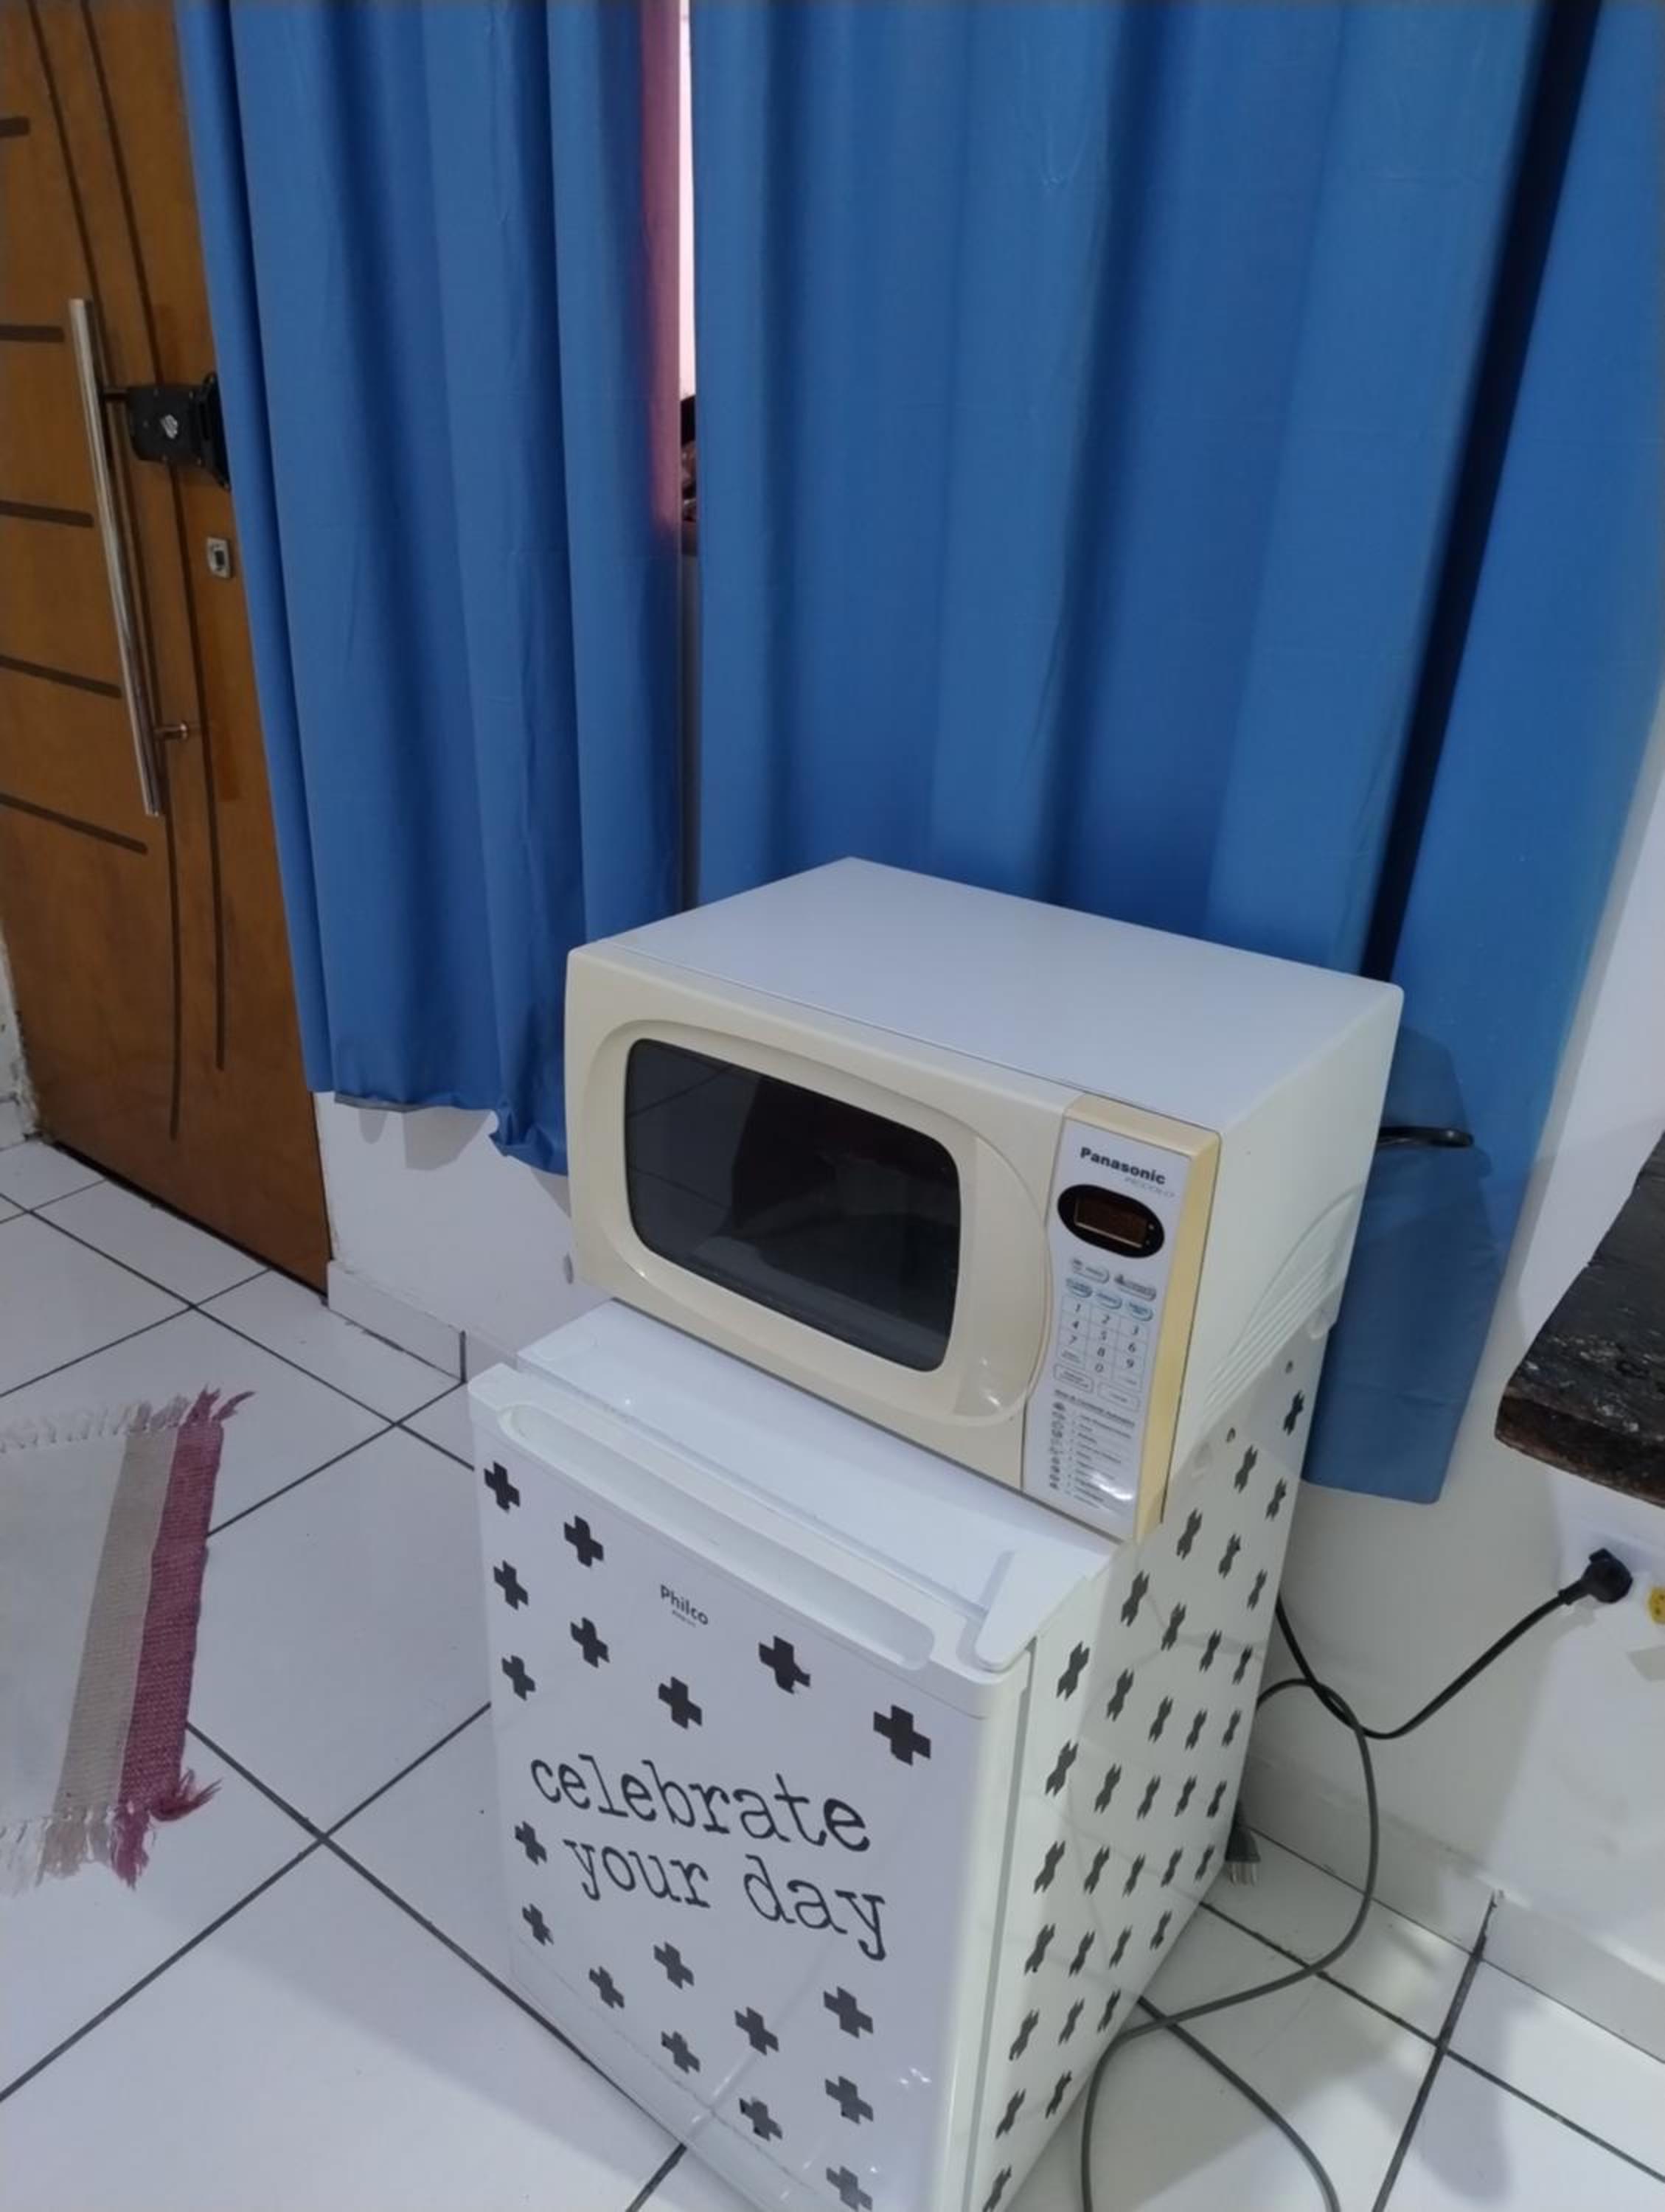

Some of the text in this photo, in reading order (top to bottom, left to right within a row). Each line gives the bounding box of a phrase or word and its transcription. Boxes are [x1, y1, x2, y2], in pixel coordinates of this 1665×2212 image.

[1080, 1147, 1166, 1185] Panasonic
[661, 1584, 709, 1625] Philco
[530, 1753, 871, 1852] celebrate
[562, 1838, 887, 1961] your day
